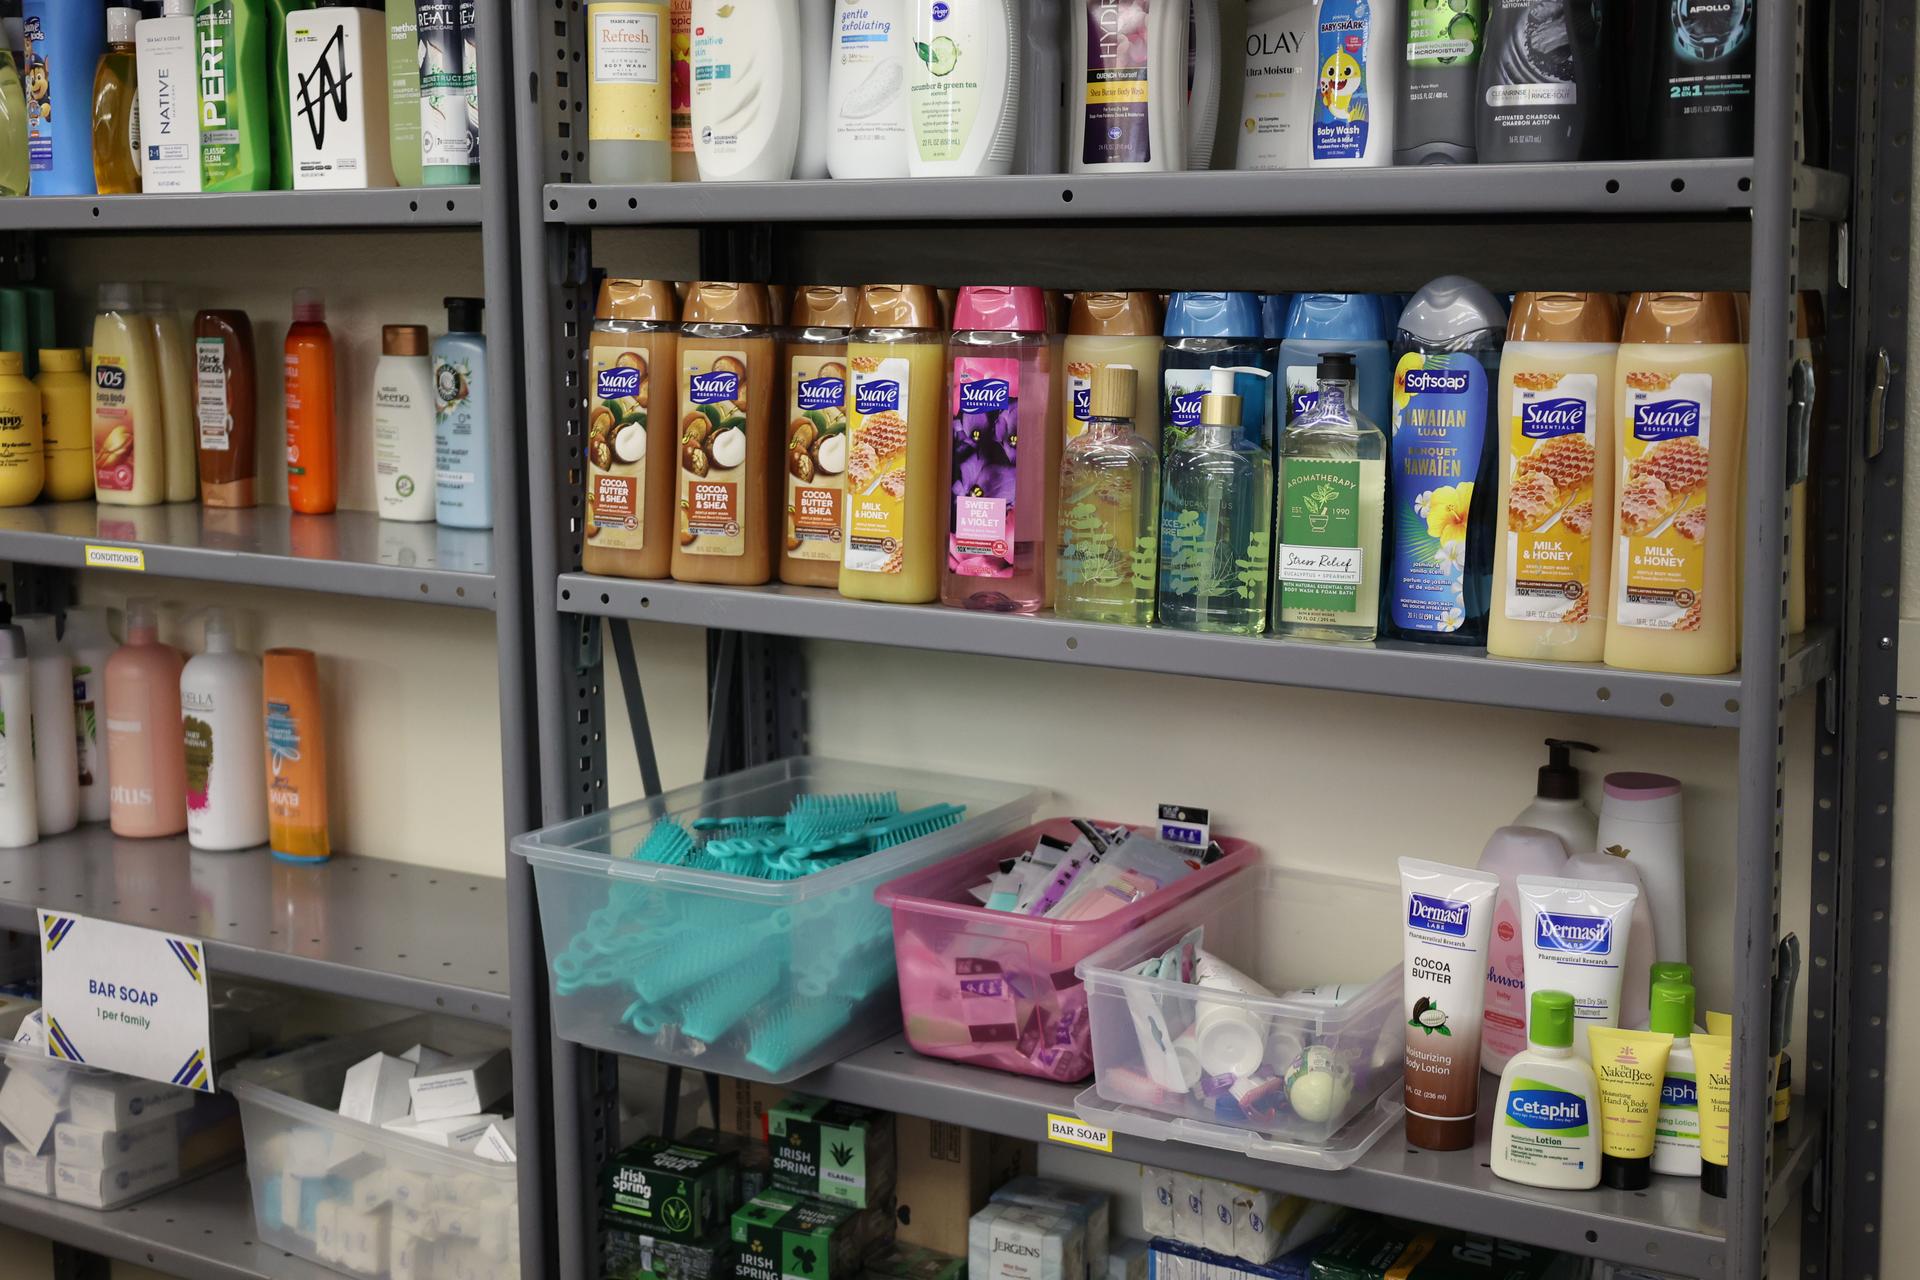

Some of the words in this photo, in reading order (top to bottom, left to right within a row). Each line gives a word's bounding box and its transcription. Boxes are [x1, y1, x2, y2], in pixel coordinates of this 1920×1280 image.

[842, 9, 869, 23] gentle
[1690, 4, 1730, 14] APOLLO
[842, 21, 891, 33] exfoliating
[1337, 20, 1363, 30] SHARK
[603, 29, 649, 43] Refresh
[1247, 31, 1306, 57] OLAY
[201, 32, 226, 126] PERT
[943, 82, 964, 90] green
[1670, 86, 1680, 98] 2
[1692, 85, 1702, 96] 1
[159, 69, 170, 134] NATIVE
[1317, 127, 1335, 137] Baby
[1336, 126, 1359, 134] Wash
[599, 371, 637, 388] Suave
[692, 376, 736, 393] Suave
[1407, 371, 1466, 391] Softsoap
[799, 382, 842, 399] Suave
[856, 386, 897, 403] Suave
[962, 383, 1007, 402] Suave
[1524, 403, 1582, 425] Suave
[1636, 405, 1695, 427] Suave
[1417, 428, 1446, 437] LUAU
[600, 478, 627, 488] COCOA
[696, 485, 727, 493] COCOA
[1288, 474, 1357, 490] AROMATHERAPY
[599, 486, 629, 496] BUTTER
[696, 493, 728, 501] BUTTER
[802, 490, 832, 500] COCOA
[600, 495, 606, 503] &
[607, 495, 627, 504] SHEA
[801, 498, 833, 508] BUTTER
[862, 502, 880, 511] MILK
[965, 500, 994, 509] SWEET
[802, 506, 808, 515] &
[809, 507, 832, 516] SHEA
[855, 510, 860, 518] &
[861, 511, 889, 520] HONEY
[970, 510, 988, 518] PEA
[968, 519, 999, 527] VIOLET
[1534, 541, 1562, 551] MILK
[1645, 546, 1674, 557] MILK
[90, 552, 139, 563] CONDITIONER
[1523, 550, 1530, 559] &
[1533, 552, 1573, 560] HONEY
[1634, 556, 1641, 565] &
[1644, 557, 1685, 567] HONEY
[1287, 553, 1315, 566] Stress
[1319, 554, 1352, 572] Relief
[1411, 899, 1468, 926] Dermasil
[1427, 922, 1445, 931] LABS
[1540, 918, 1609, 942] Dermasil
[1443, 937, 1466, 947] Research
[1414, 956, 1451, 973] COCOA
[1538, 953, 1581, 963] Pharmaceutical
[1582, 957, 1608, 965] Research
[1412, 968, 1452, 984] BUTTER
[89, 979, 116, 999] BAR
[120, 987, 159, 1006] SOAP
[1588, 998, 1596, 1007] Dry
[97, 1008, 100, 1017] 1
[103, 1009, 118, 1021] per
[120, 1010, 150, 1030] family
[1406, 1045, 1452, 1065] Moisturizing
[1405, 1056, 1420, 1072] Body
[1421, 1061, 1450, 1076] Lotion
[1601, 1065, 1632, 1077] Naked
[1632, 1069, 1651, 1080] Bee
[1512, 1097, 1580, 1120] Cetaphil
[1604, 1096, 1621, 1105] Hand
[1631, 1100, 1648, 1109] Body
[1674, 1118, 1697, 1127] Lotion
[1052, 1123, 1074, 1136] BAR
[1077, 1128, 1106, 1141] SOAP
[1536, 1136, 1561, 1145] Lotion
[779, 1146, 811, 1163] IRISH
[773, 1157, 816, 1177] SPRING
[620, 1167, 646, 1185] Irish
[612, 1176, 651, 1199] Spring
[992, 1237, 1040, 1258] JERGENS
[741, 1253, 773, 1270] IRISH
[736, 1265, 779, 1280] SPRING
